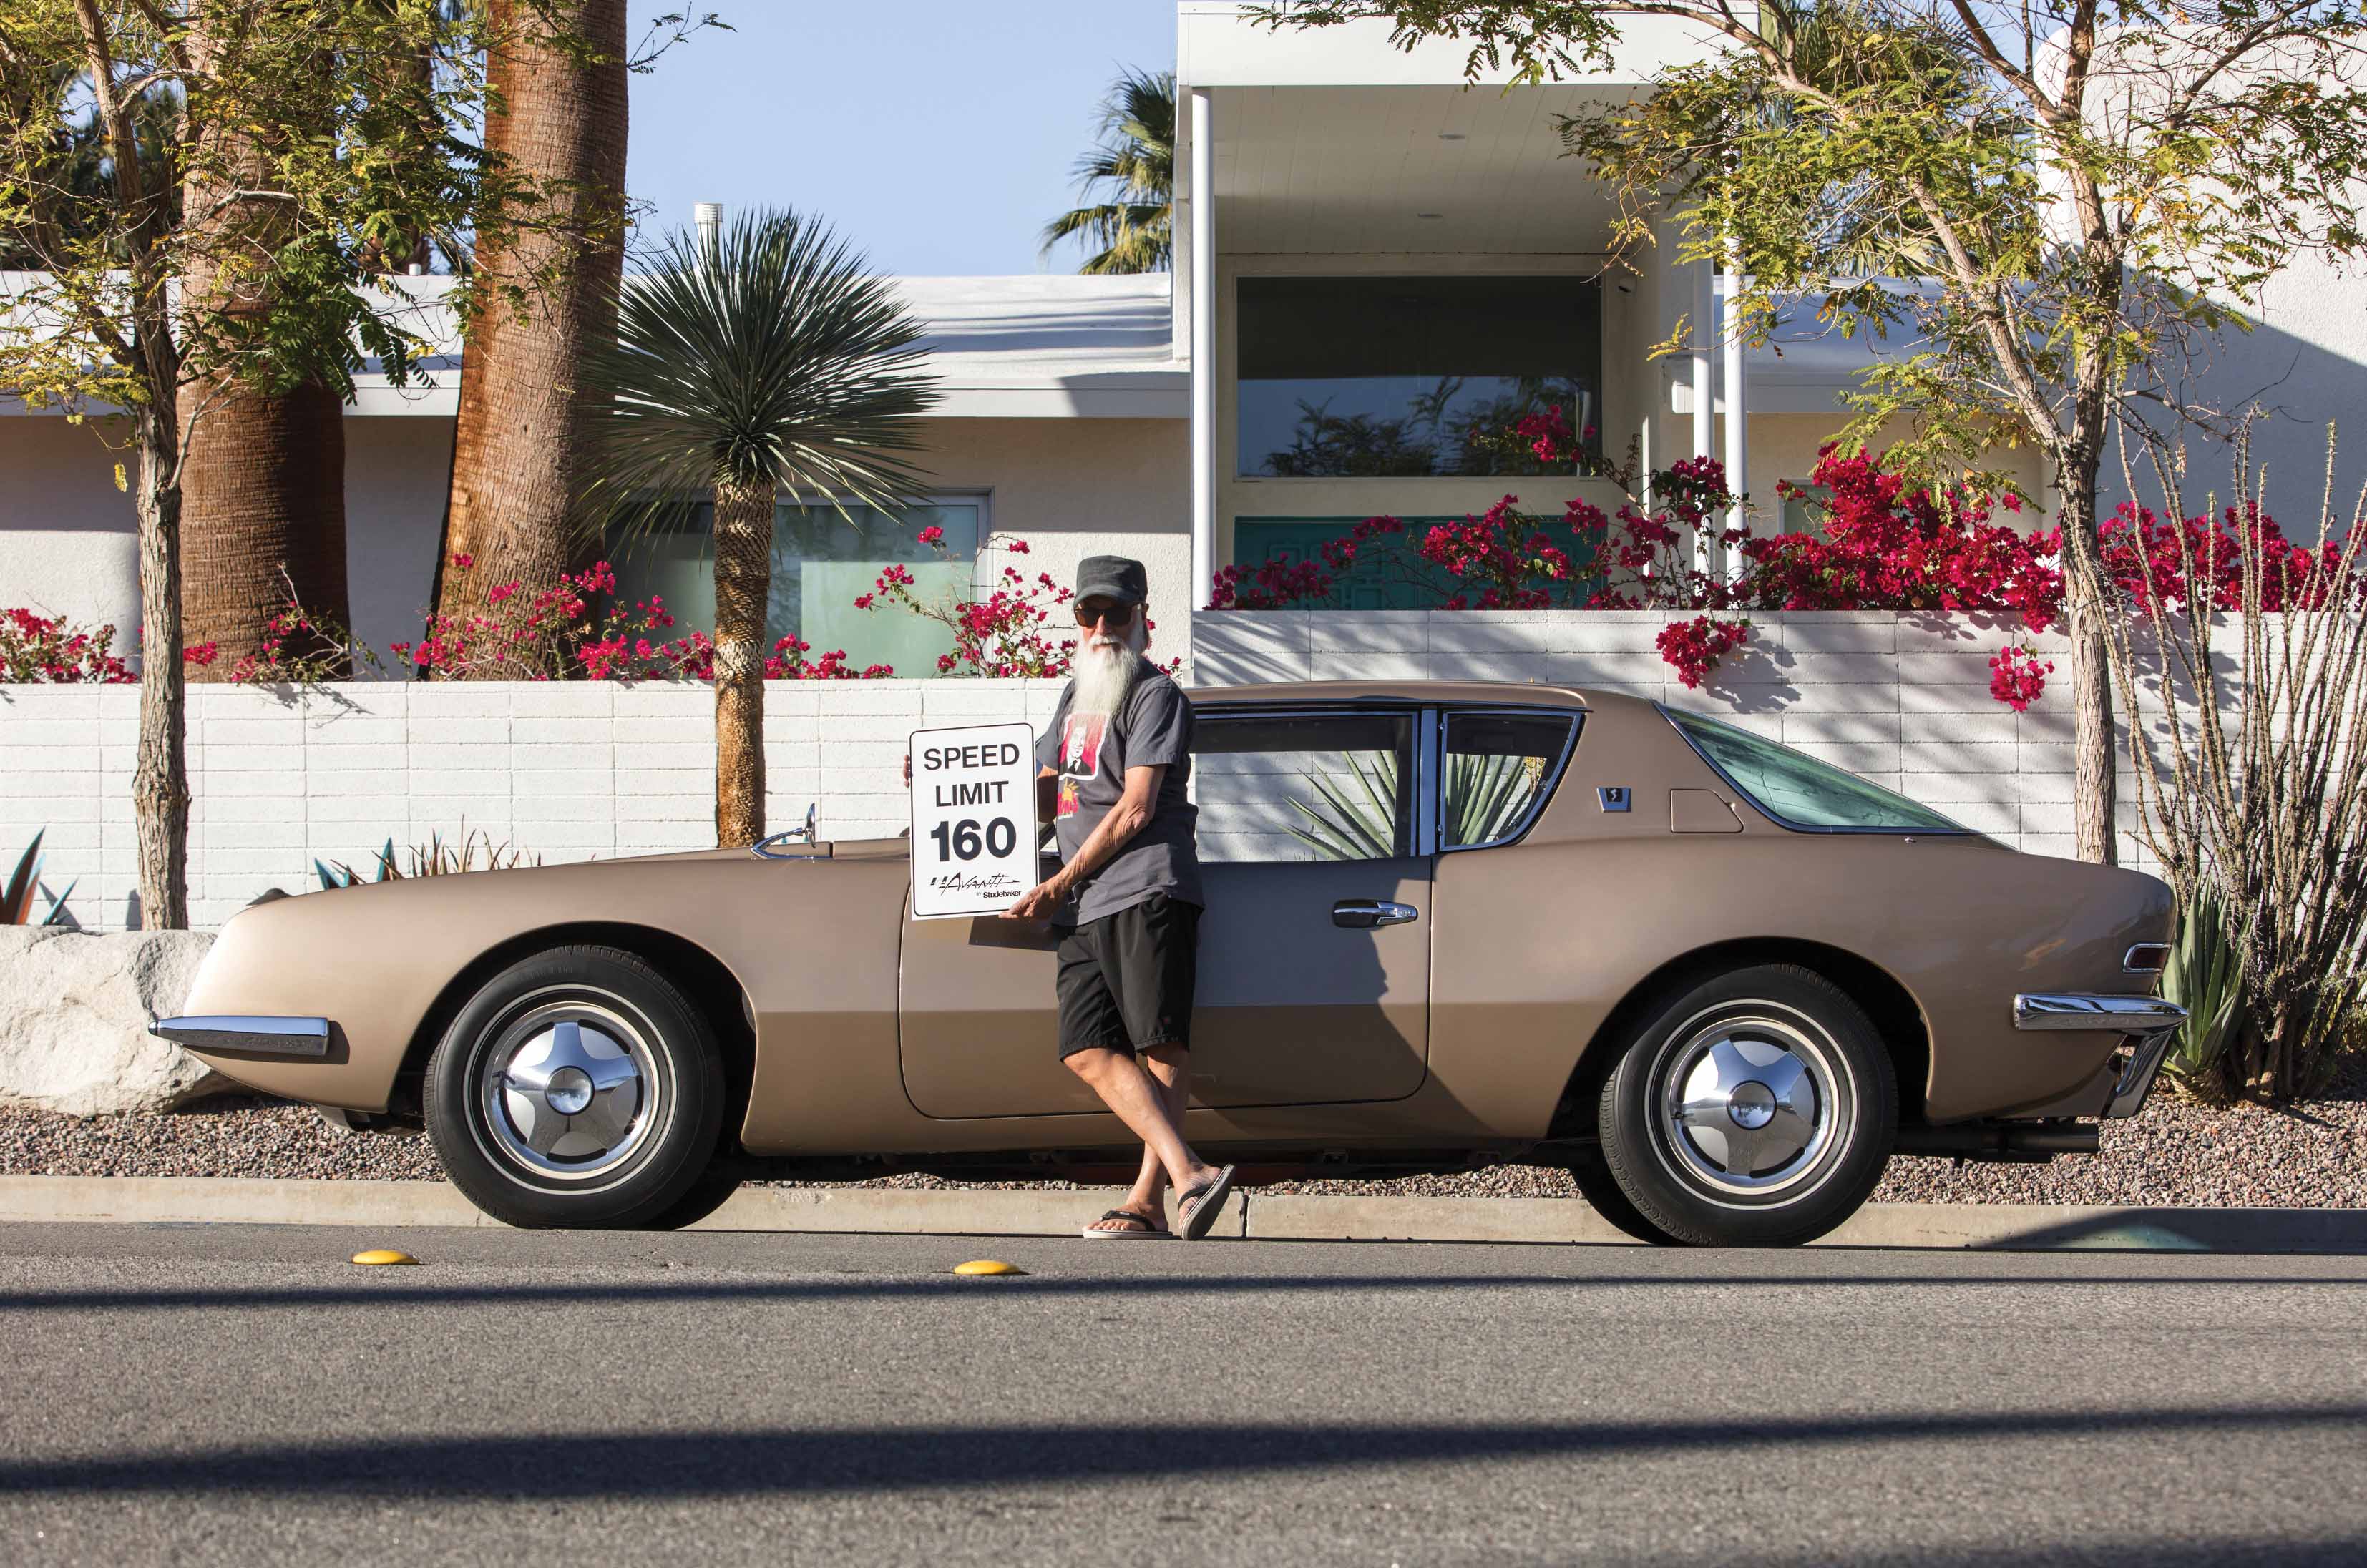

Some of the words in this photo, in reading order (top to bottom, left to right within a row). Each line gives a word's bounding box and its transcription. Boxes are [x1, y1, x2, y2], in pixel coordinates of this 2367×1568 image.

[924, 744, 1019, 770] SPEED
[936, 781, 1008, 807] LIMIT
[931, 817, 1016, 861] 160
